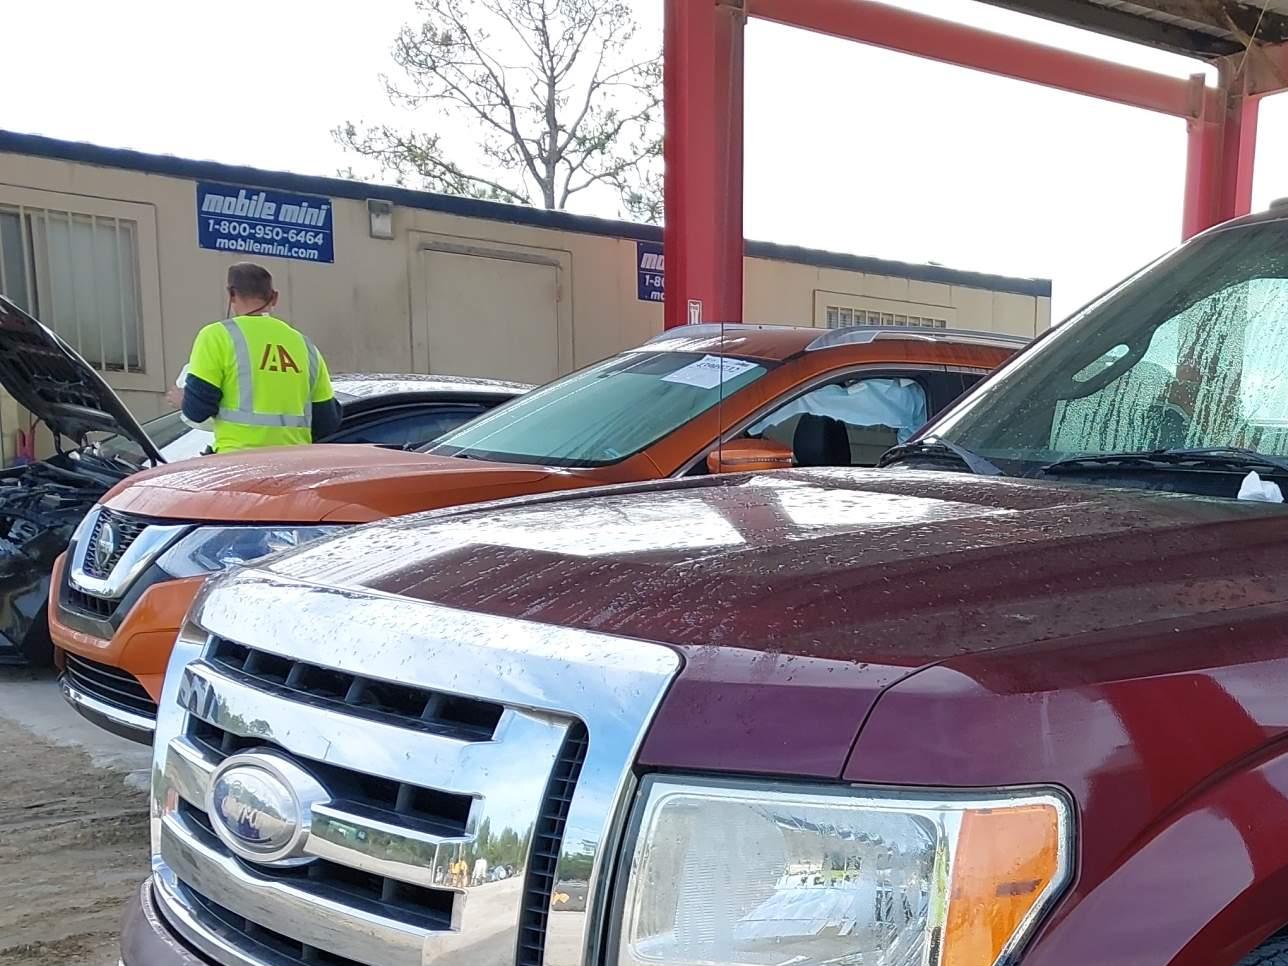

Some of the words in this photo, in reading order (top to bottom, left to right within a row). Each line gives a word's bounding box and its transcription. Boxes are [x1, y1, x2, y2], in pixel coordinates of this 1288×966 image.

[201, 189, 277, 220] mobile
[278, 202, 329, 226] mini
[207, 219, 324, 246] 1-800-950-6464
[215, 237, 319, 259] mobilemini.com
